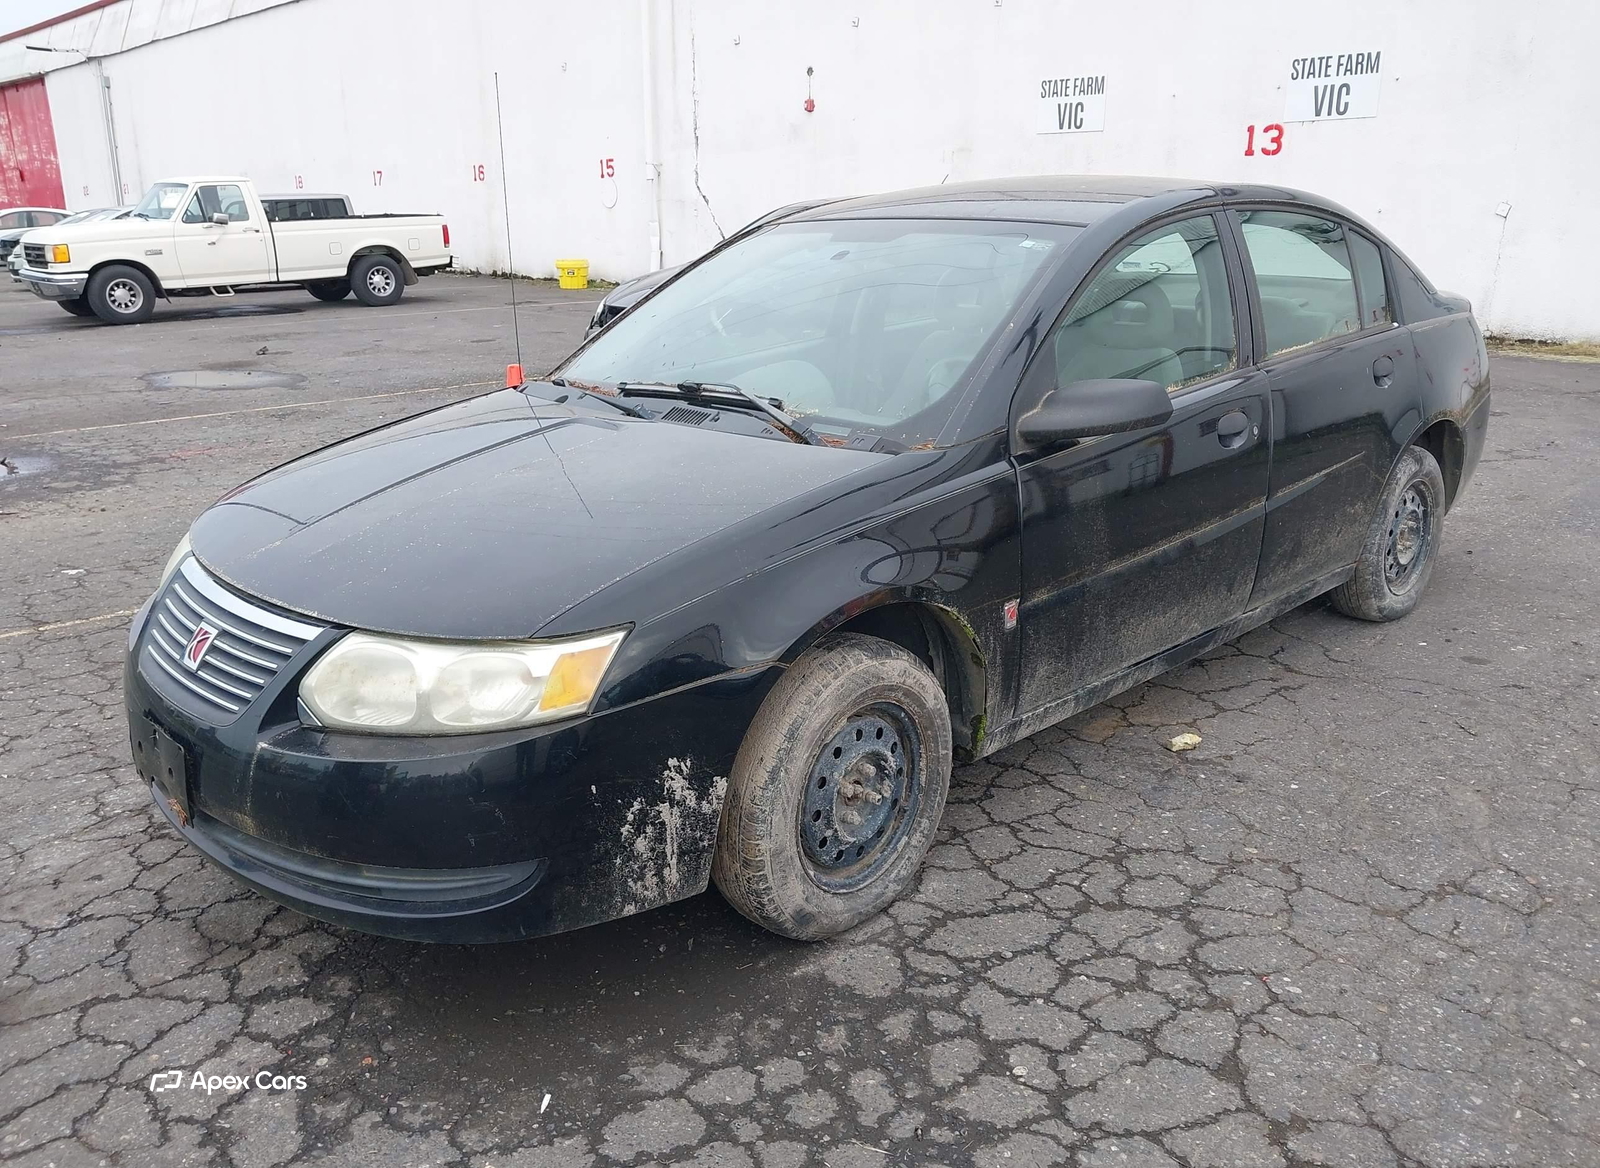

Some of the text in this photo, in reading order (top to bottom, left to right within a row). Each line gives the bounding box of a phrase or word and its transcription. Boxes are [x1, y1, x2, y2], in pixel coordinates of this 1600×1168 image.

[1291, 51, 1381, 80] STATE FARM
[1041, 75, 1105, 98] STATE FARM
[1314, 82, 1351, 117] VIC
[1057, 101, 1084, 130] VIC
[1244, 123, 1285, 156] 13
[373, 170, 383, 186] 17
[473, 164, 485, 181] 16
[600, 158, 615, 178] 15
[295, 175, 303, 189] 18
